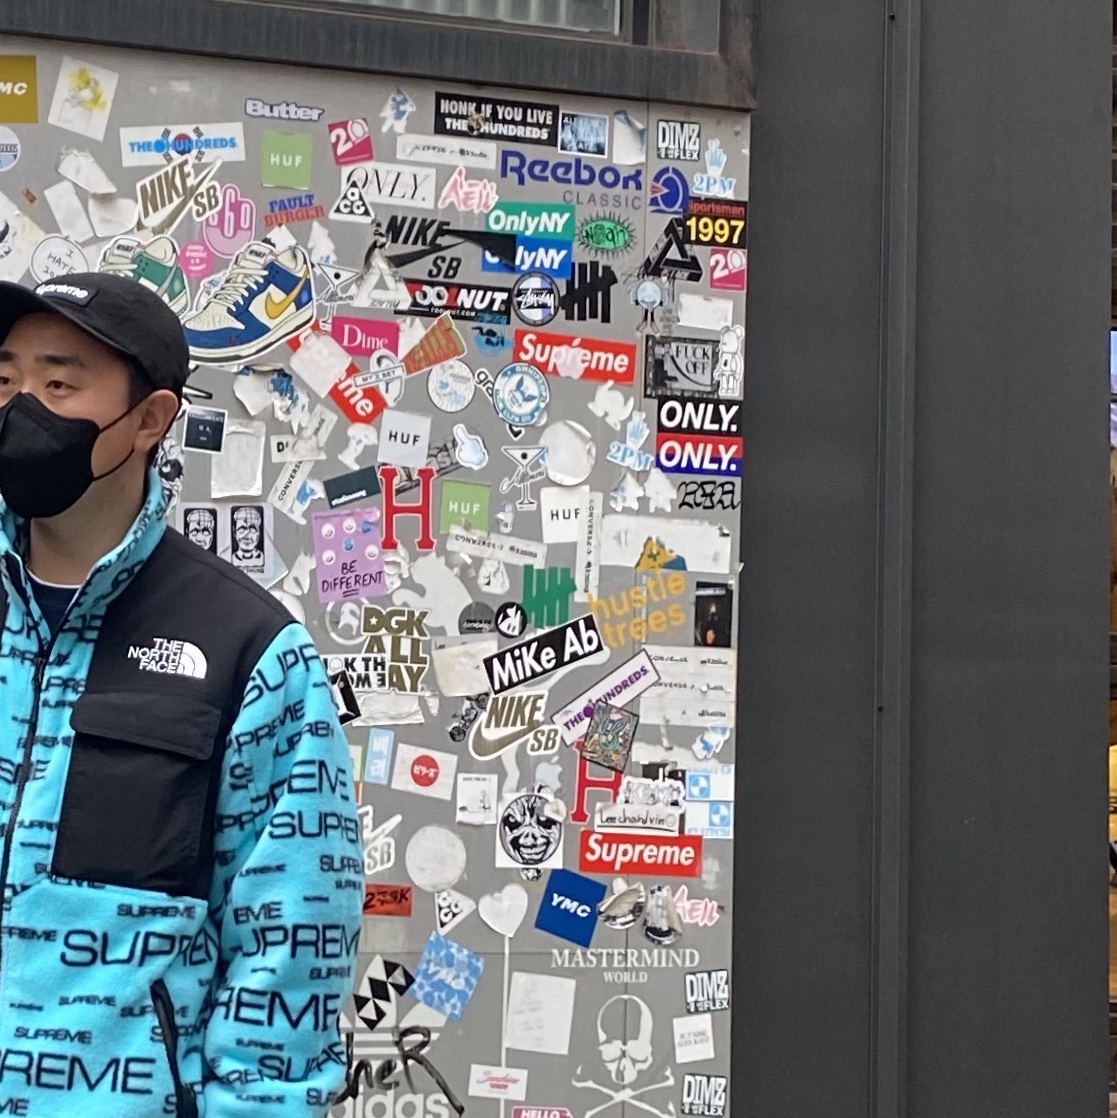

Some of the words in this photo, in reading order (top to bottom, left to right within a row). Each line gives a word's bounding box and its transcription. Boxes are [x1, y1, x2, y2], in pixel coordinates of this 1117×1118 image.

[246, 100, 324, 120] Butter
[440, 100, 479, 116] HONK
[496, 106, 522, 121] YOU
[526, 108, 553, 125] LIVE
[444, 118, 468, 130] THE
[657, 121, 700, 150] DIMZ
[129, 142, 154, 153] THE
[270, 156, 303, 166] HUF
[501, 150, 642, 191] Reebok
[141, 159, 194, 219] NIKE
[693, 174, 736, 197] 2PM
[194, 187, 219, 217] SB
[269, 195, 314, 212] FAULT
[563, 189, 642, 211] CLASSIC
[264, 207, 325, 227] BURGER
[488, 210, 571, 233] OnlyNY
[387, 215, 451, 246] NIKE
[686, 218, 745, 243] 1997
[428, 256, 462, 279] SB
[343, 328, 388, 349] Dime
[676, 344, 712, 361] FUCK
[685, 361, 707, 376] OFF
[660, 402, 738, 432] ONLY.
[388, 431, 421, 446] HUF
[658, 441, 737, 471] ONLY.
[449, 501, 481, 515] HUF
[341, 560, 357, 575] BE
[321, 571, 382, 593] DIFFERENT
[588, 568, 687, 618] hustle
[363, 607, 429, 636] DGK
[603, 605, 687, 648] trees
[153, 637, 184, 652] THE
[365, 635, 428, 664] ALL
[564, 619, 599, 659] Ab
[127, 646, 182, 664] NORTH
[139, 660, 180, 674] FACE
[484, 694, 545, 728] NIKE
[532, 729, 557, 751] SB
[366, 842, 392, 871] SB
[585, 834, 695, 871] Supreme
[551, 893, 592, 918] YMC
[551, 949, 700, 968] MASTERMIND
[603, 971, 648, 983] WORLD
[685, 972, 728, 1002] DIMZ
[15, 1027, 92, 1045] SUPREME
[683, 1075, 726, 1105] DIMZ
